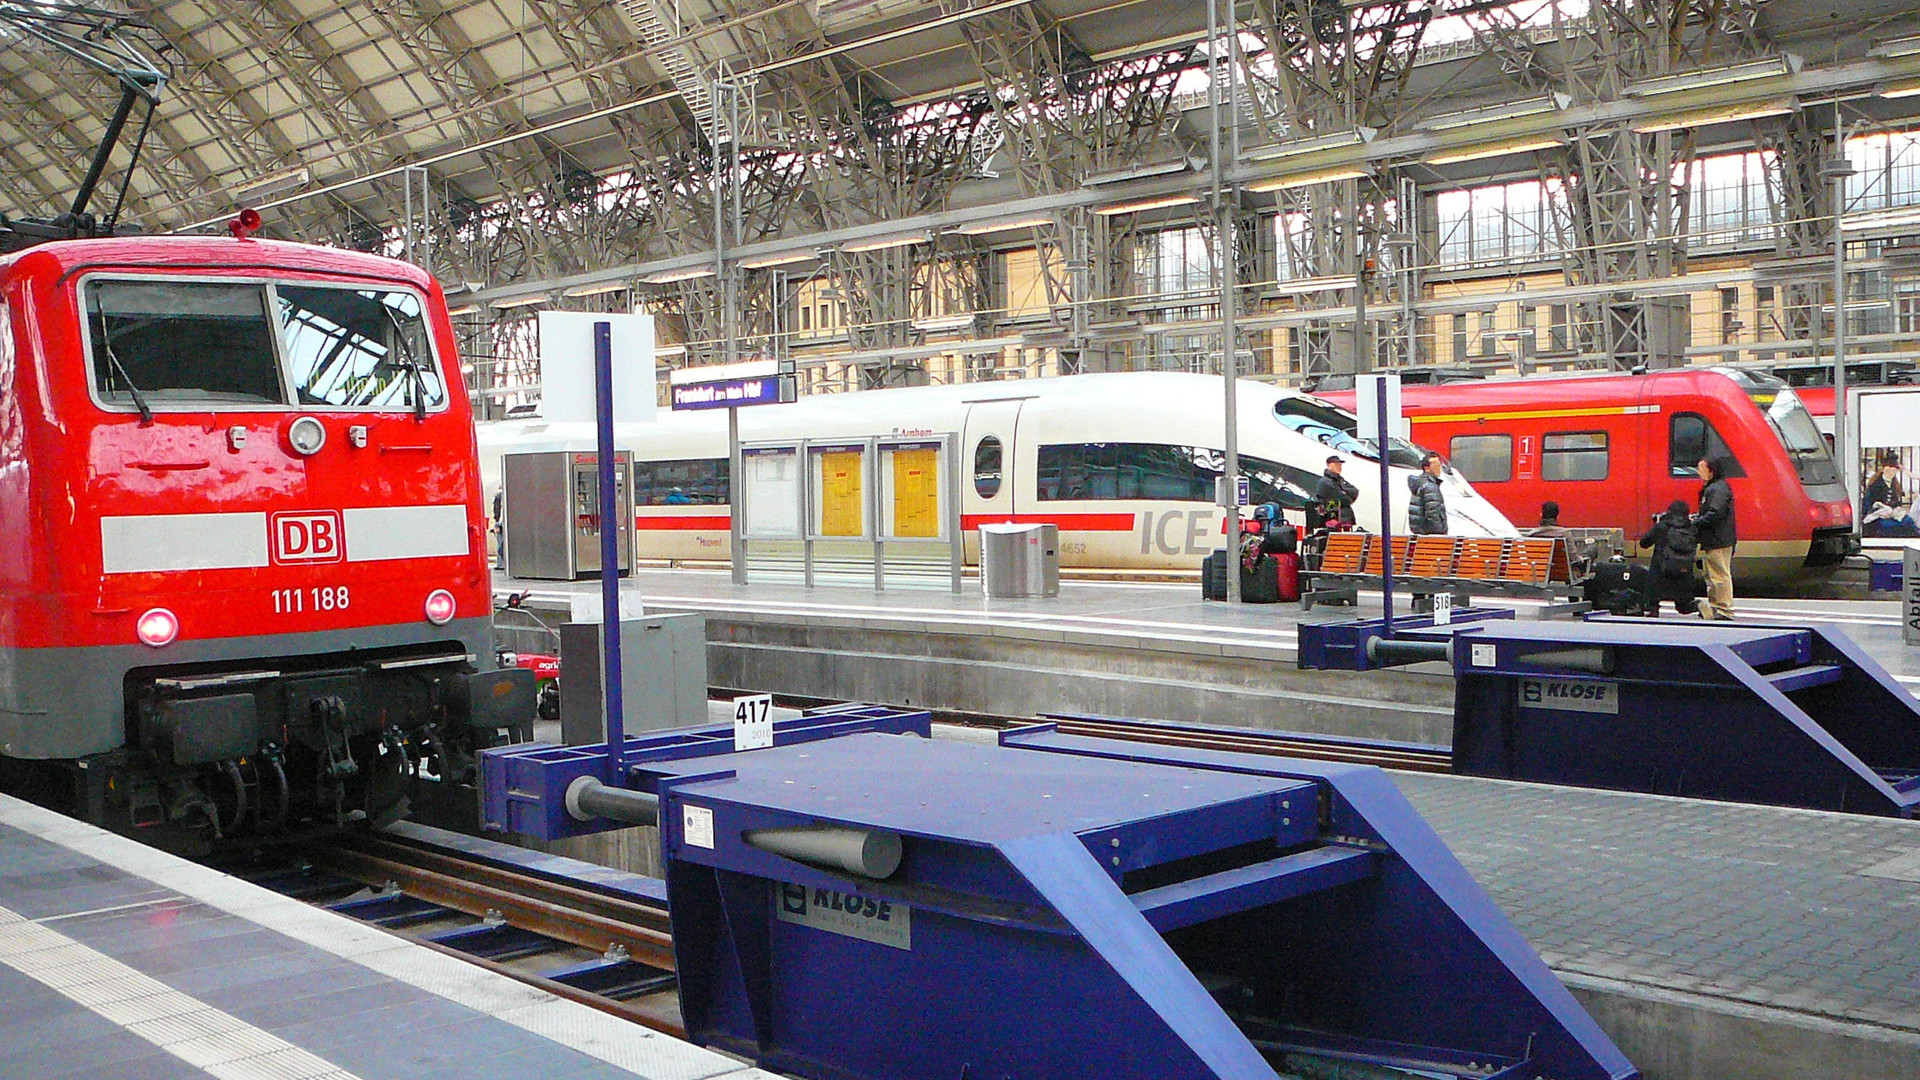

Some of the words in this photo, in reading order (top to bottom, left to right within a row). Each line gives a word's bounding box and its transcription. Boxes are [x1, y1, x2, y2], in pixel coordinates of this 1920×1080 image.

[1522, 437, 1529, 453] 1
[282, 519, 334, 555] DB
[1141, 510, 1214, 556] ICE
[271, 588, 303, 613] 111
[311, 586, 350, 611] 188
[1435, 595, 1449, 610] 518
[1547, 683, 1607, 700] KLOSE
[736, 699, 770, 725] 417
[813, 888, 893, 921] KLOSE
